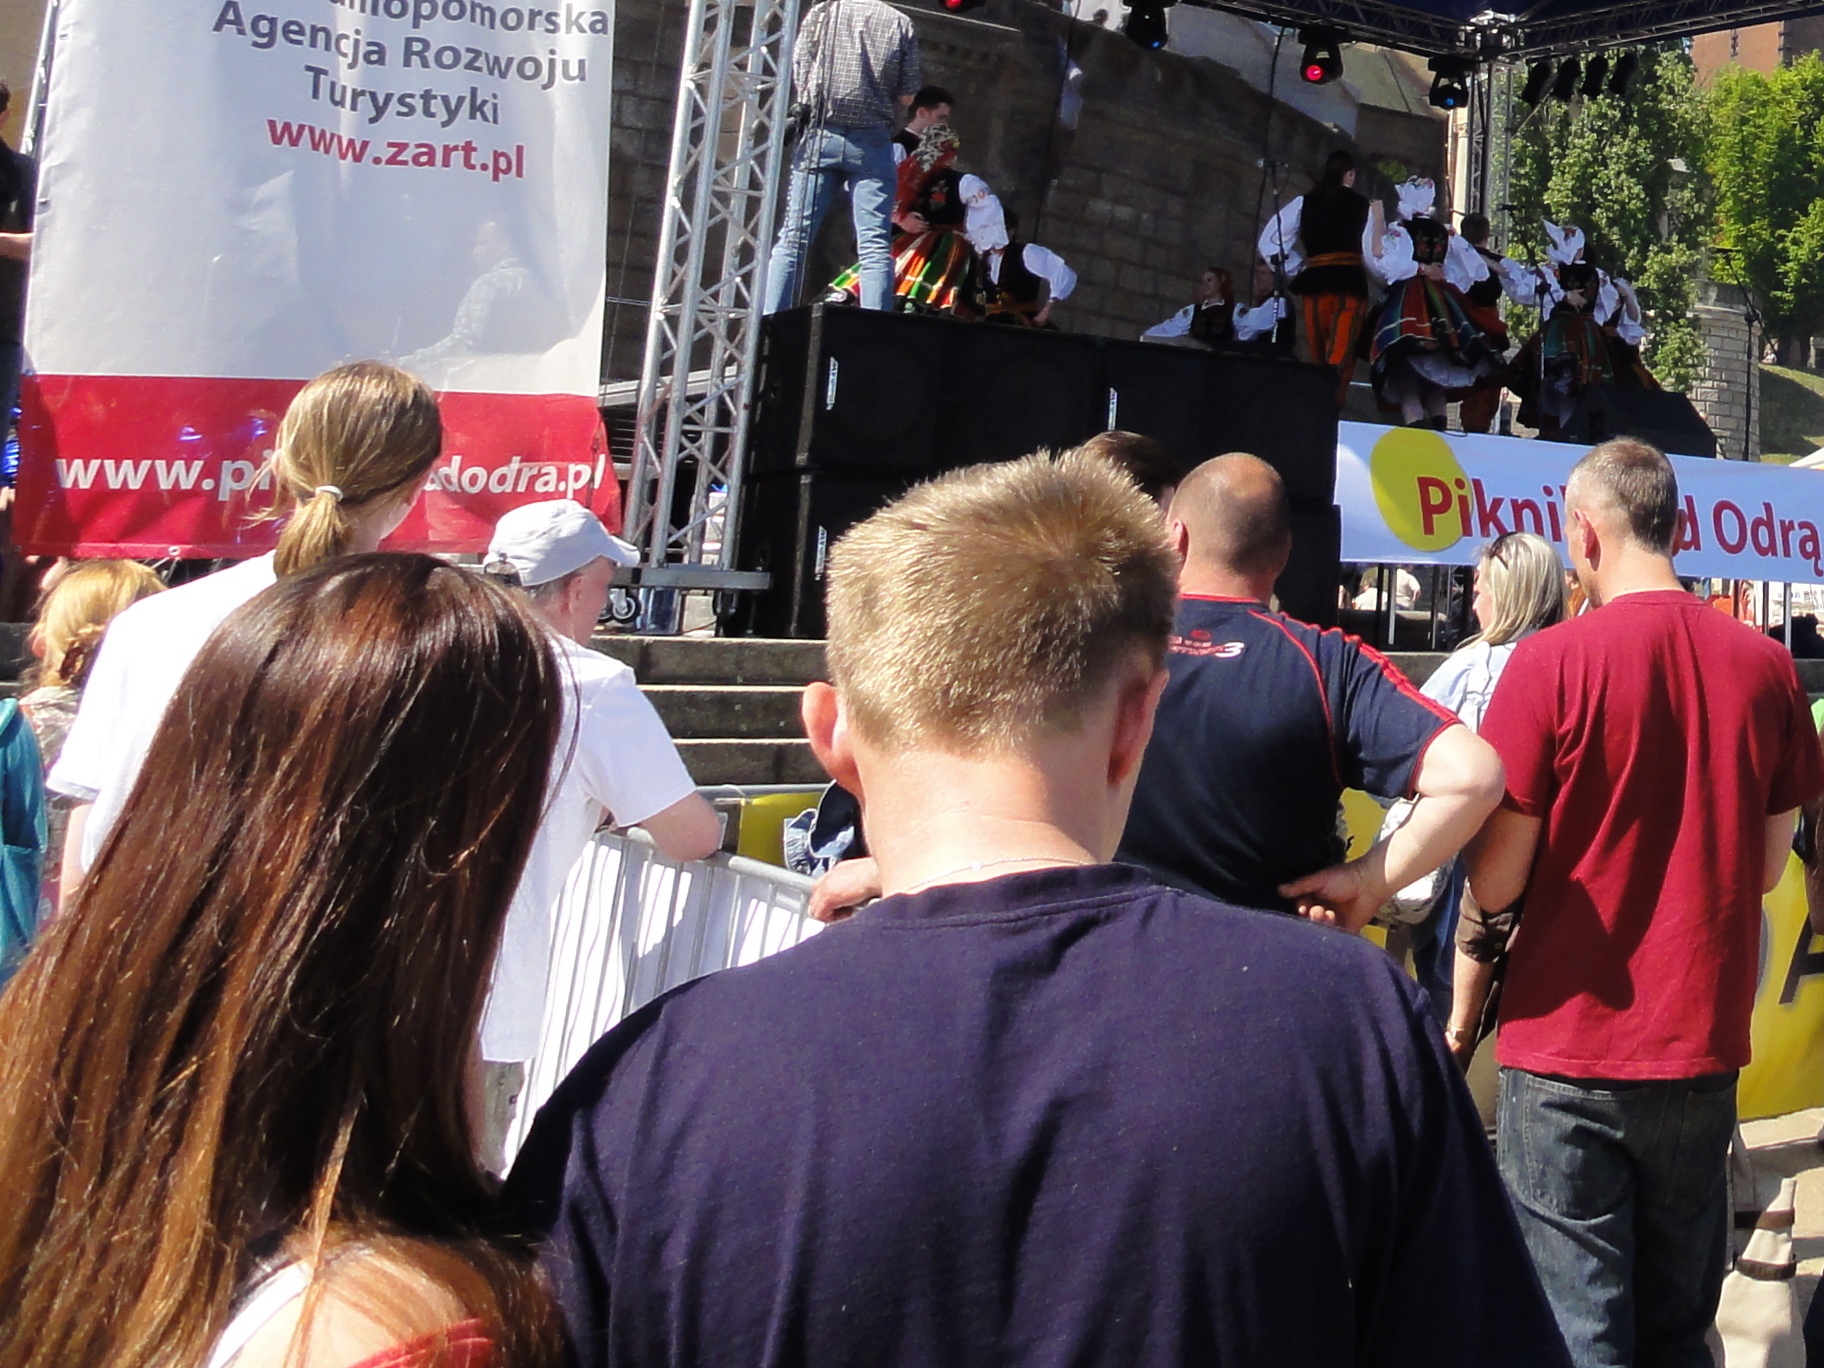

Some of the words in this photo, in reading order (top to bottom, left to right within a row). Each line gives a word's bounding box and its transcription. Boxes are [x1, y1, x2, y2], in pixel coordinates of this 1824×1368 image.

[212, 0, 387, 68] Agencja
[402, 36, 588, 91] Rozwoju
[304, 66, 500, 125] Turystyki
[266, 119, 525, 182] www.zart.pl
[1417, 476, 1568, 542] Pikni
[1712, 500, 1824, 577] Odrą
